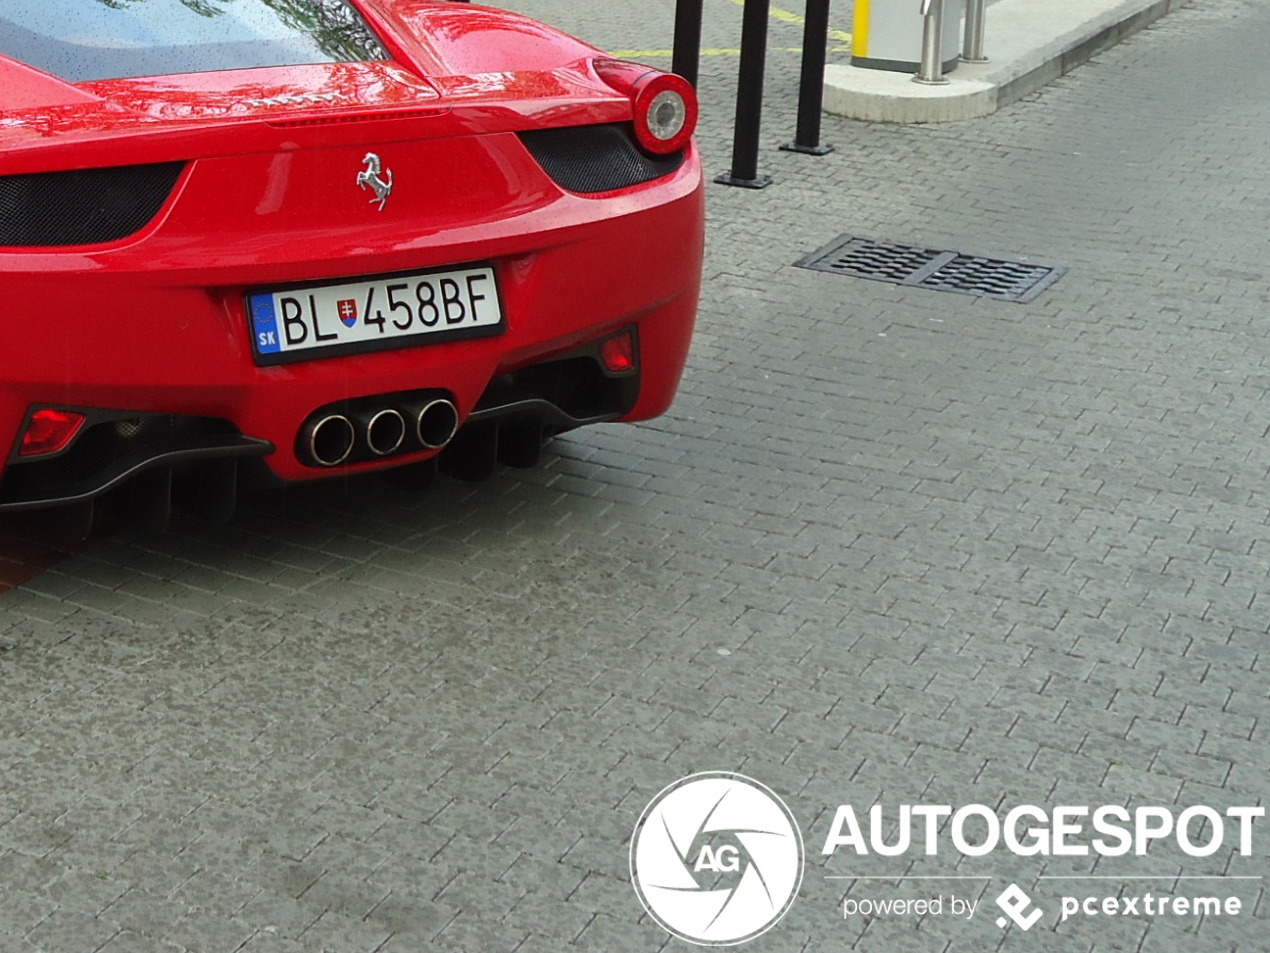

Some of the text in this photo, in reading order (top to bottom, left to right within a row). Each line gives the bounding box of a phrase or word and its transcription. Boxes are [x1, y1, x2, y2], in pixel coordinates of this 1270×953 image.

[281, 274, 488, 345] BL 458BF
[259, 331, 276, 346] SK
